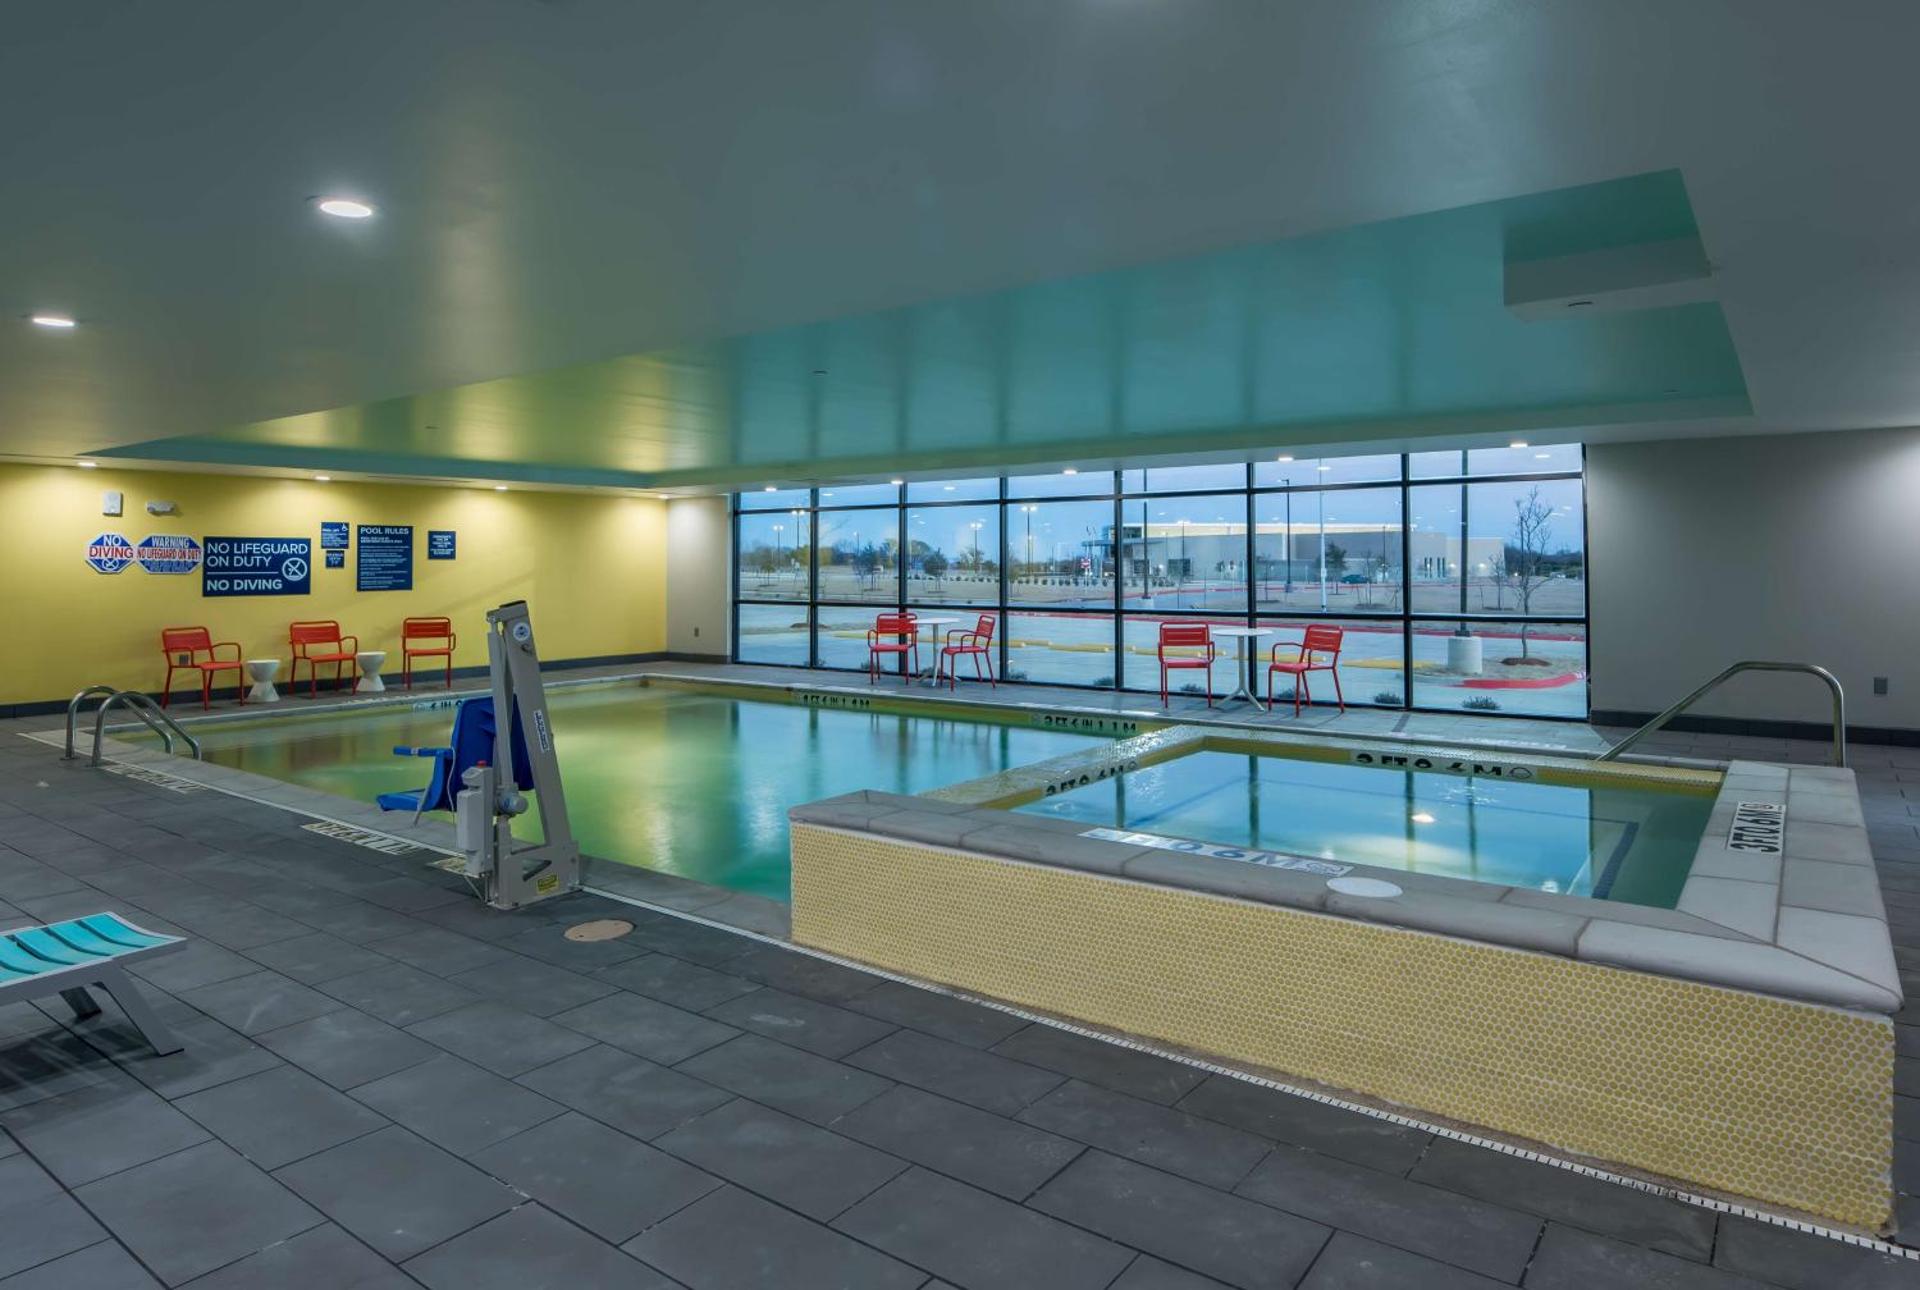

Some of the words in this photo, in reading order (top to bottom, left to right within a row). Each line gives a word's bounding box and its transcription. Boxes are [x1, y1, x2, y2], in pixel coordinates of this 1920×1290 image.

[360, 527, 383, 535] POOL
[384, 527, 409, 535] RULES
[103, 535, 122, 547] NO
[151, 536, 190, 548] WARNING
[89, 546, 134, 558] DIVING
[207, 542, 230, 554] NO
[233, 543, 308, 555] LIFEGUARD
[206, 555, 229, 567] ON
[233, 556, 271, 568] DUTY
[206, 579, 230, 591] NO
[233, 579, 282, 591] DIVING
